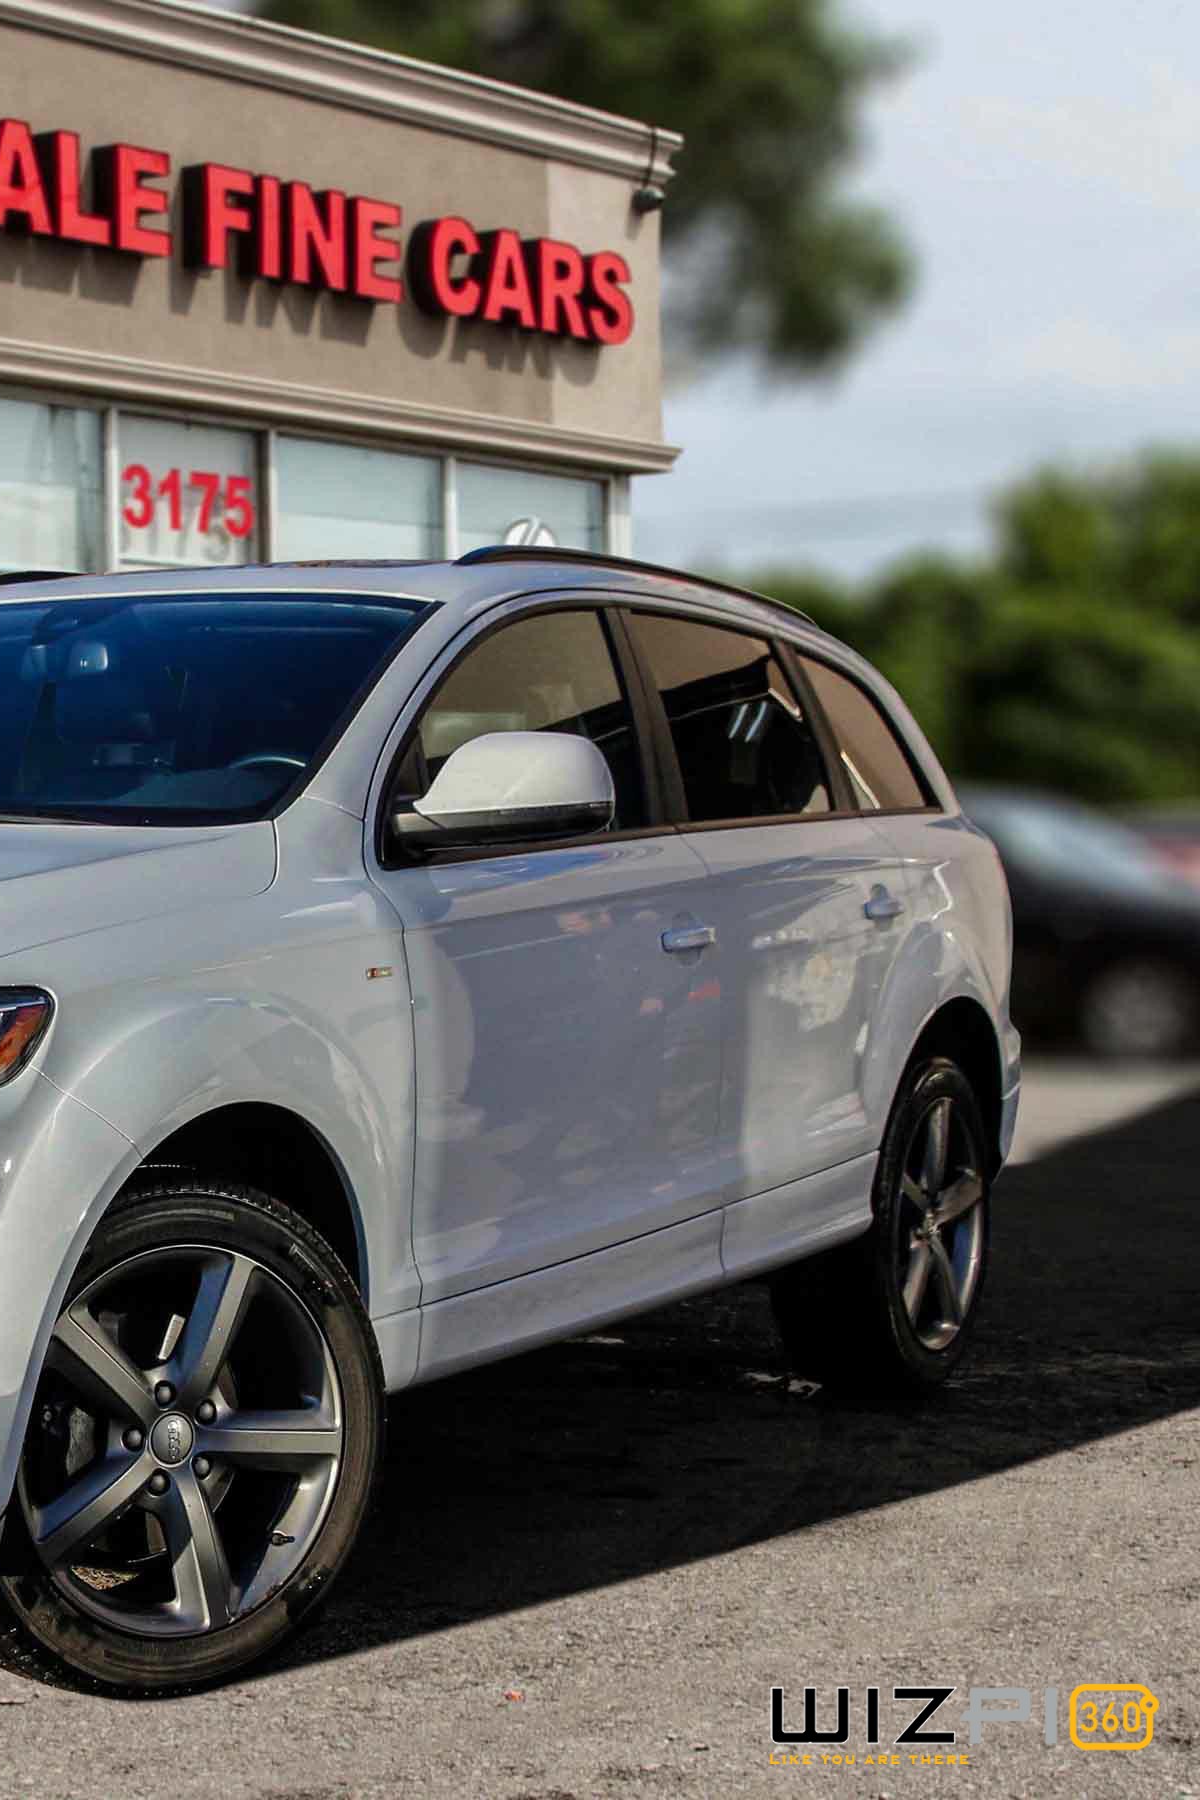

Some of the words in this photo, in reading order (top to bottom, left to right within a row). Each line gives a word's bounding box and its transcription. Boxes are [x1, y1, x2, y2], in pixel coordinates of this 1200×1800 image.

[184, 162, 402, 304] FINE
[412, 215, 636, 346] CARS
[122, 463, 255, 539] 3175
